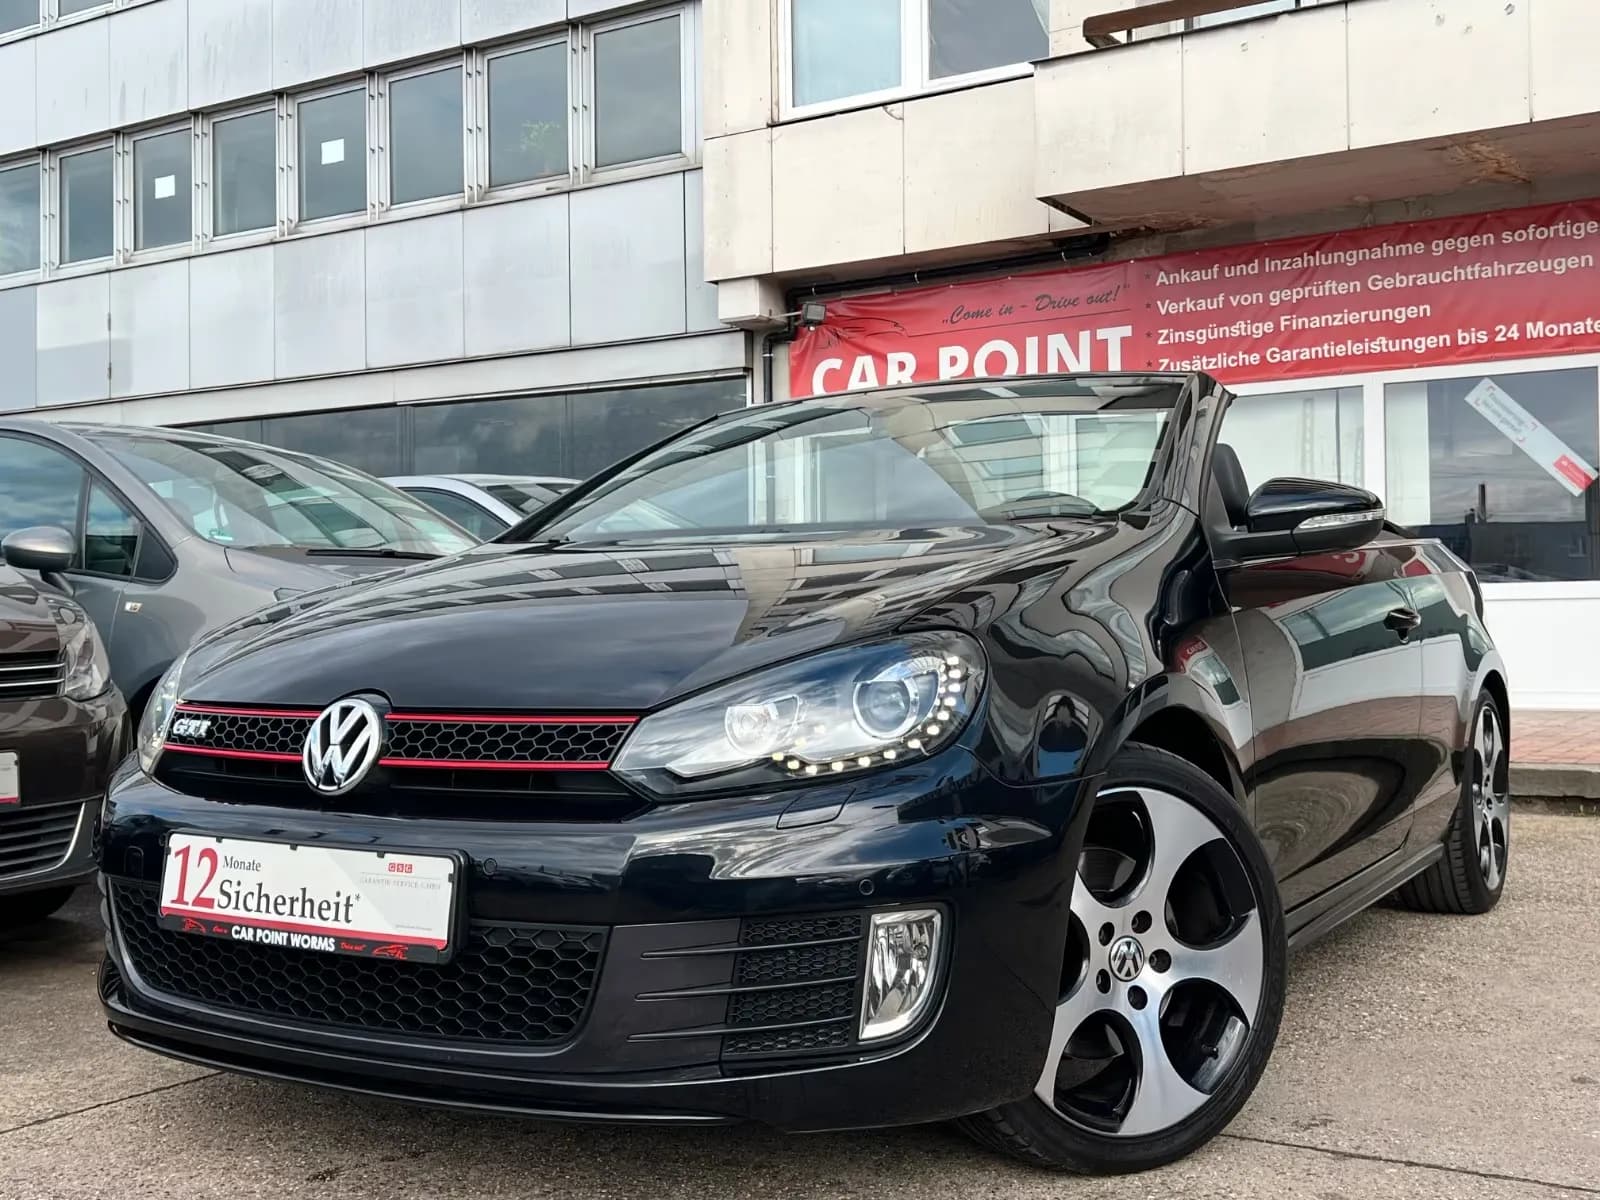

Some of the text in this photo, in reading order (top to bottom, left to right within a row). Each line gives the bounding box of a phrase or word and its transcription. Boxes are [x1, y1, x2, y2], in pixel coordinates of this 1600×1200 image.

[1156, 219, 1599, 287] Ankauf und Inzahlungnahme gegen sofortige
[998, 303, 1014, 316] in
[1035, 294, 1079, 311] Drive
[1156, 254, 1593, 316] Verkauf von geprüften Gebrauchtfahrzeugen
[1157, 303, 1431, 345] Zinsgünstige Finanzierungen
[1158, 351, 1261, 371] Zusätzliche
[1266, 332, 1450, 363] Garantieleistungen
[1457, 328, 1488, 346] bis
[1494, 323, 1520, 342] 24
[812, 325, 1132, 395] CAR POINT
[173, 719, 211, 737] GTI
[170, 844, 261, 909] 12 Monate
[231, 925, 254, 942] CAR
[256, 928, 289, 946] POINT
[290, 933, 336, 952] WORMS
